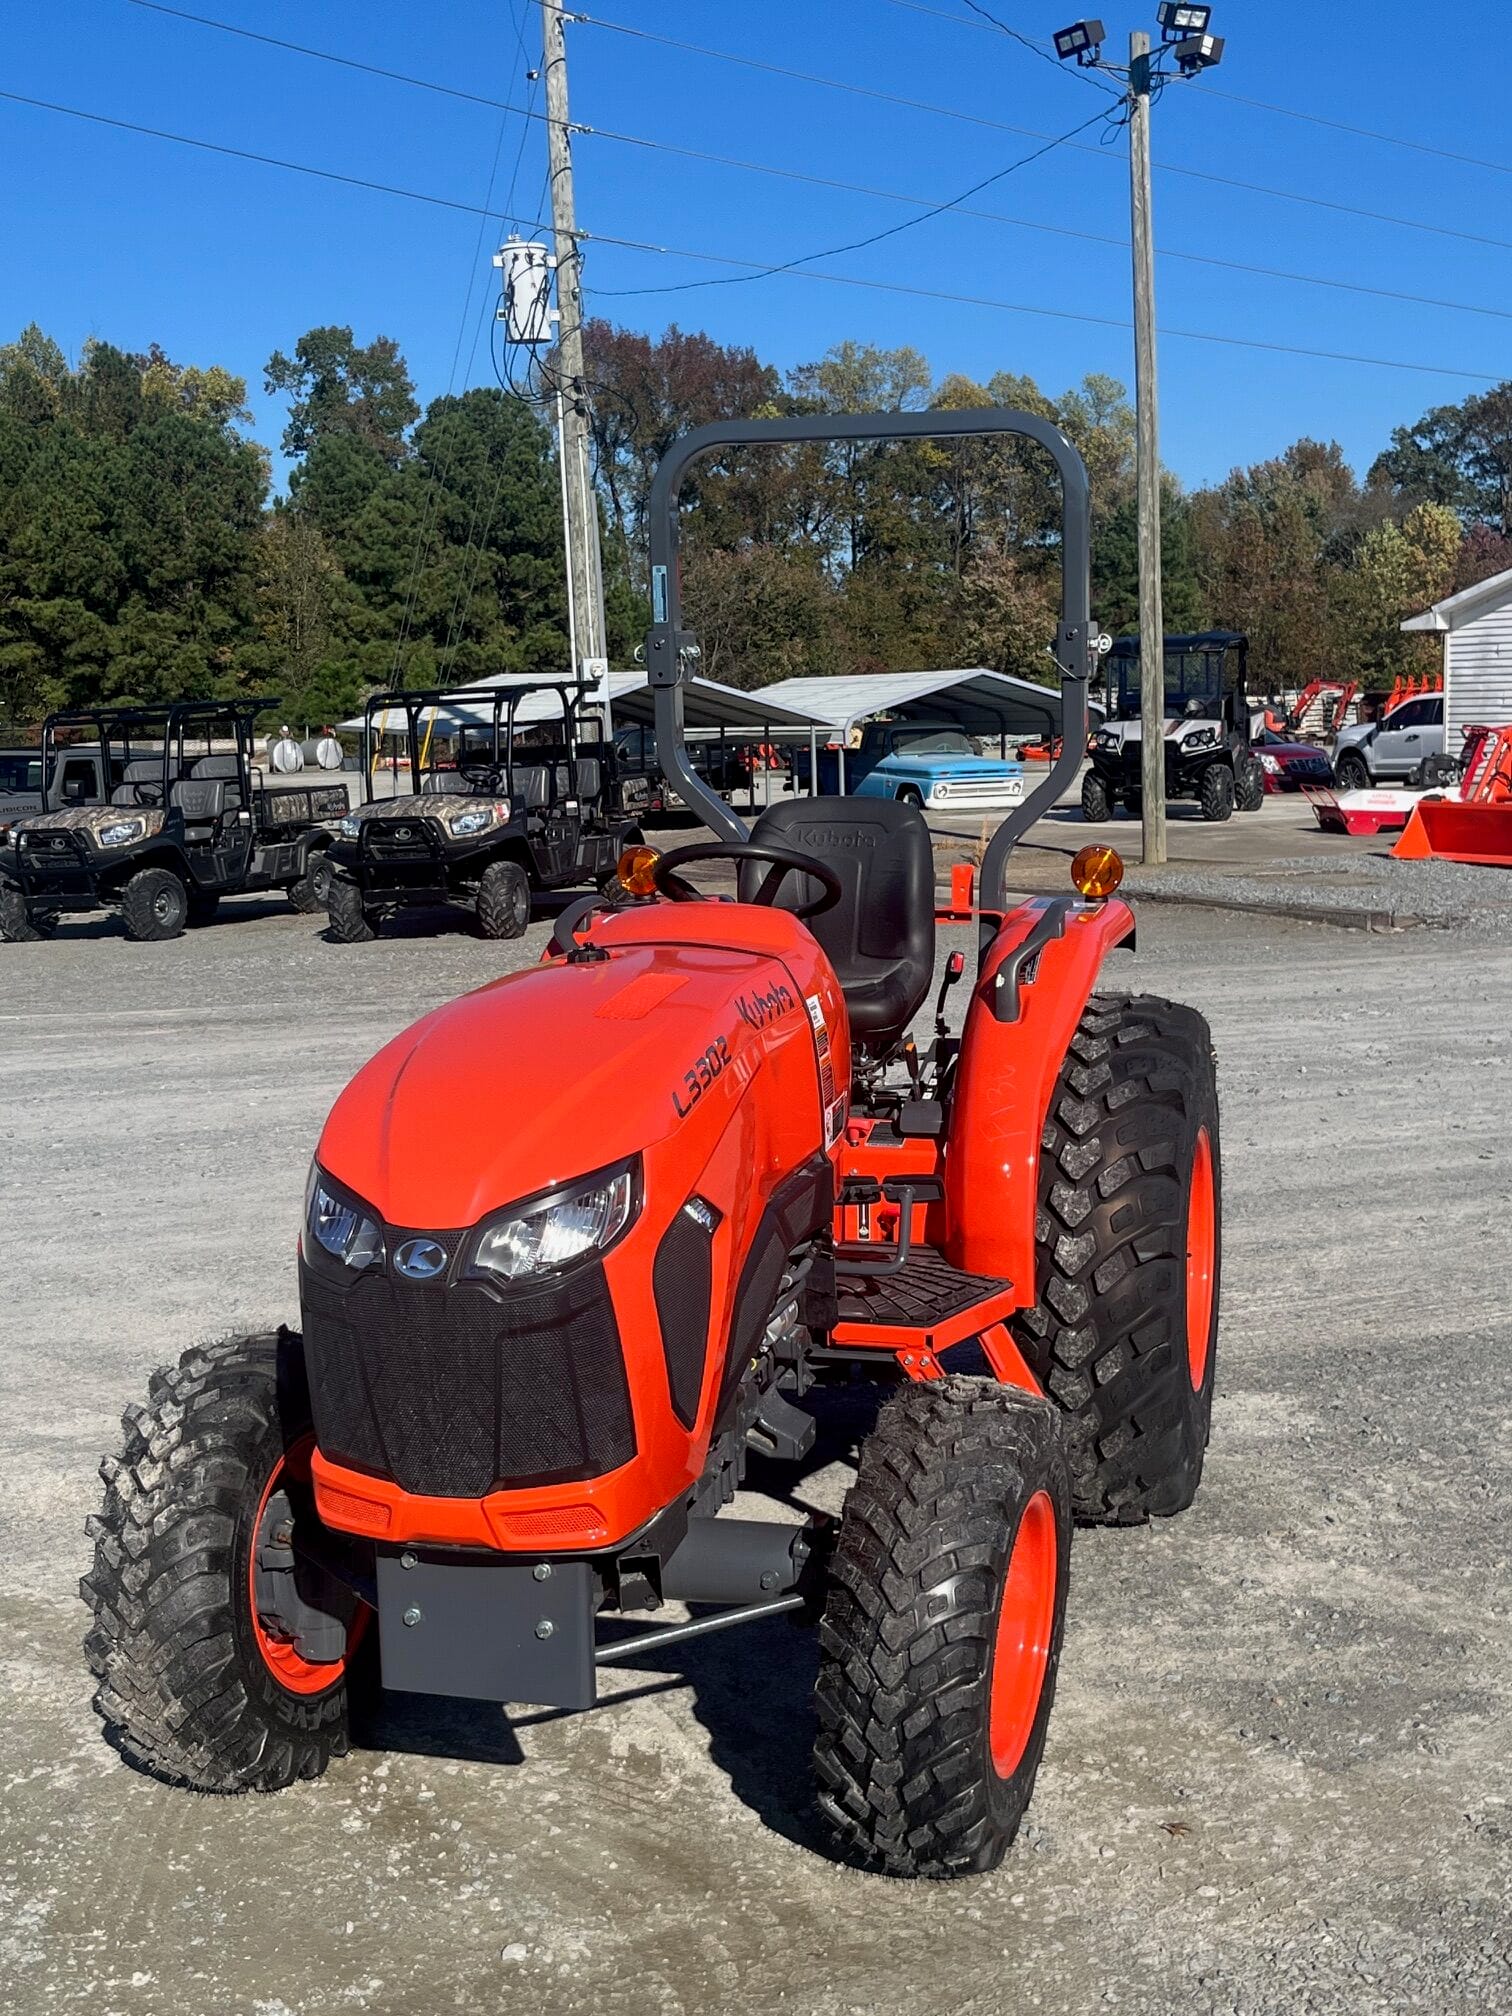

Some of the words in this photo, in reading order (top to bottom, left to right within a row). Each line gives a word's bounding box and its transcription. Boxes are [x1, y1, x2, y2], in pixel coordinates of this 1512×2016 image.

[797, 829, 876, 848] Kubota
[734, 981, 795, 1030] Kubota
[672, 1035, 732, 1119] L3302
